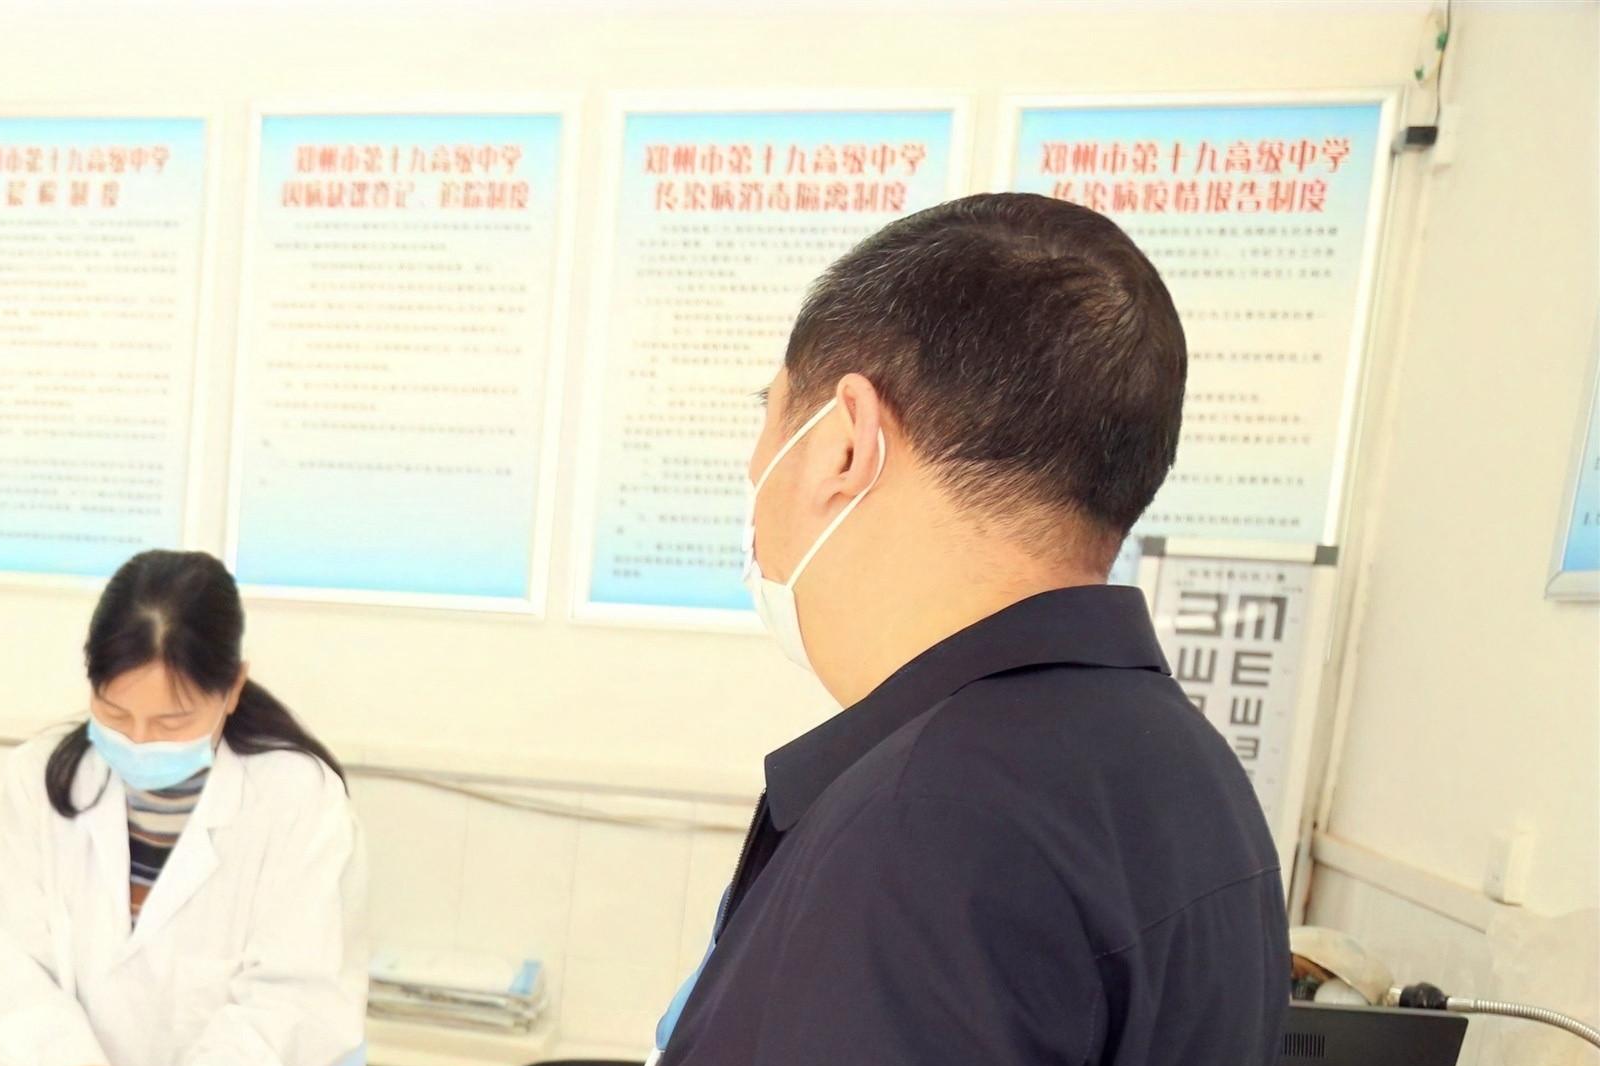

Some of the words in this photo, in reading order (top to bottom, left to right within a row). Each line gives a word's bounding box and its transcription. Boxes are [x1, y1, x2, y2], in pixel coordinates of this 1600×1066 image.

[297, 145, 521, 173] 郑州市第十九高级中学
[646, 144, 925, 175] 郑州市第十九高级中学
[1042, 139, 1349, 174] 郑州市第十九高级中学
[656, 181, 906, 211] 传染病消毒隔离制度
